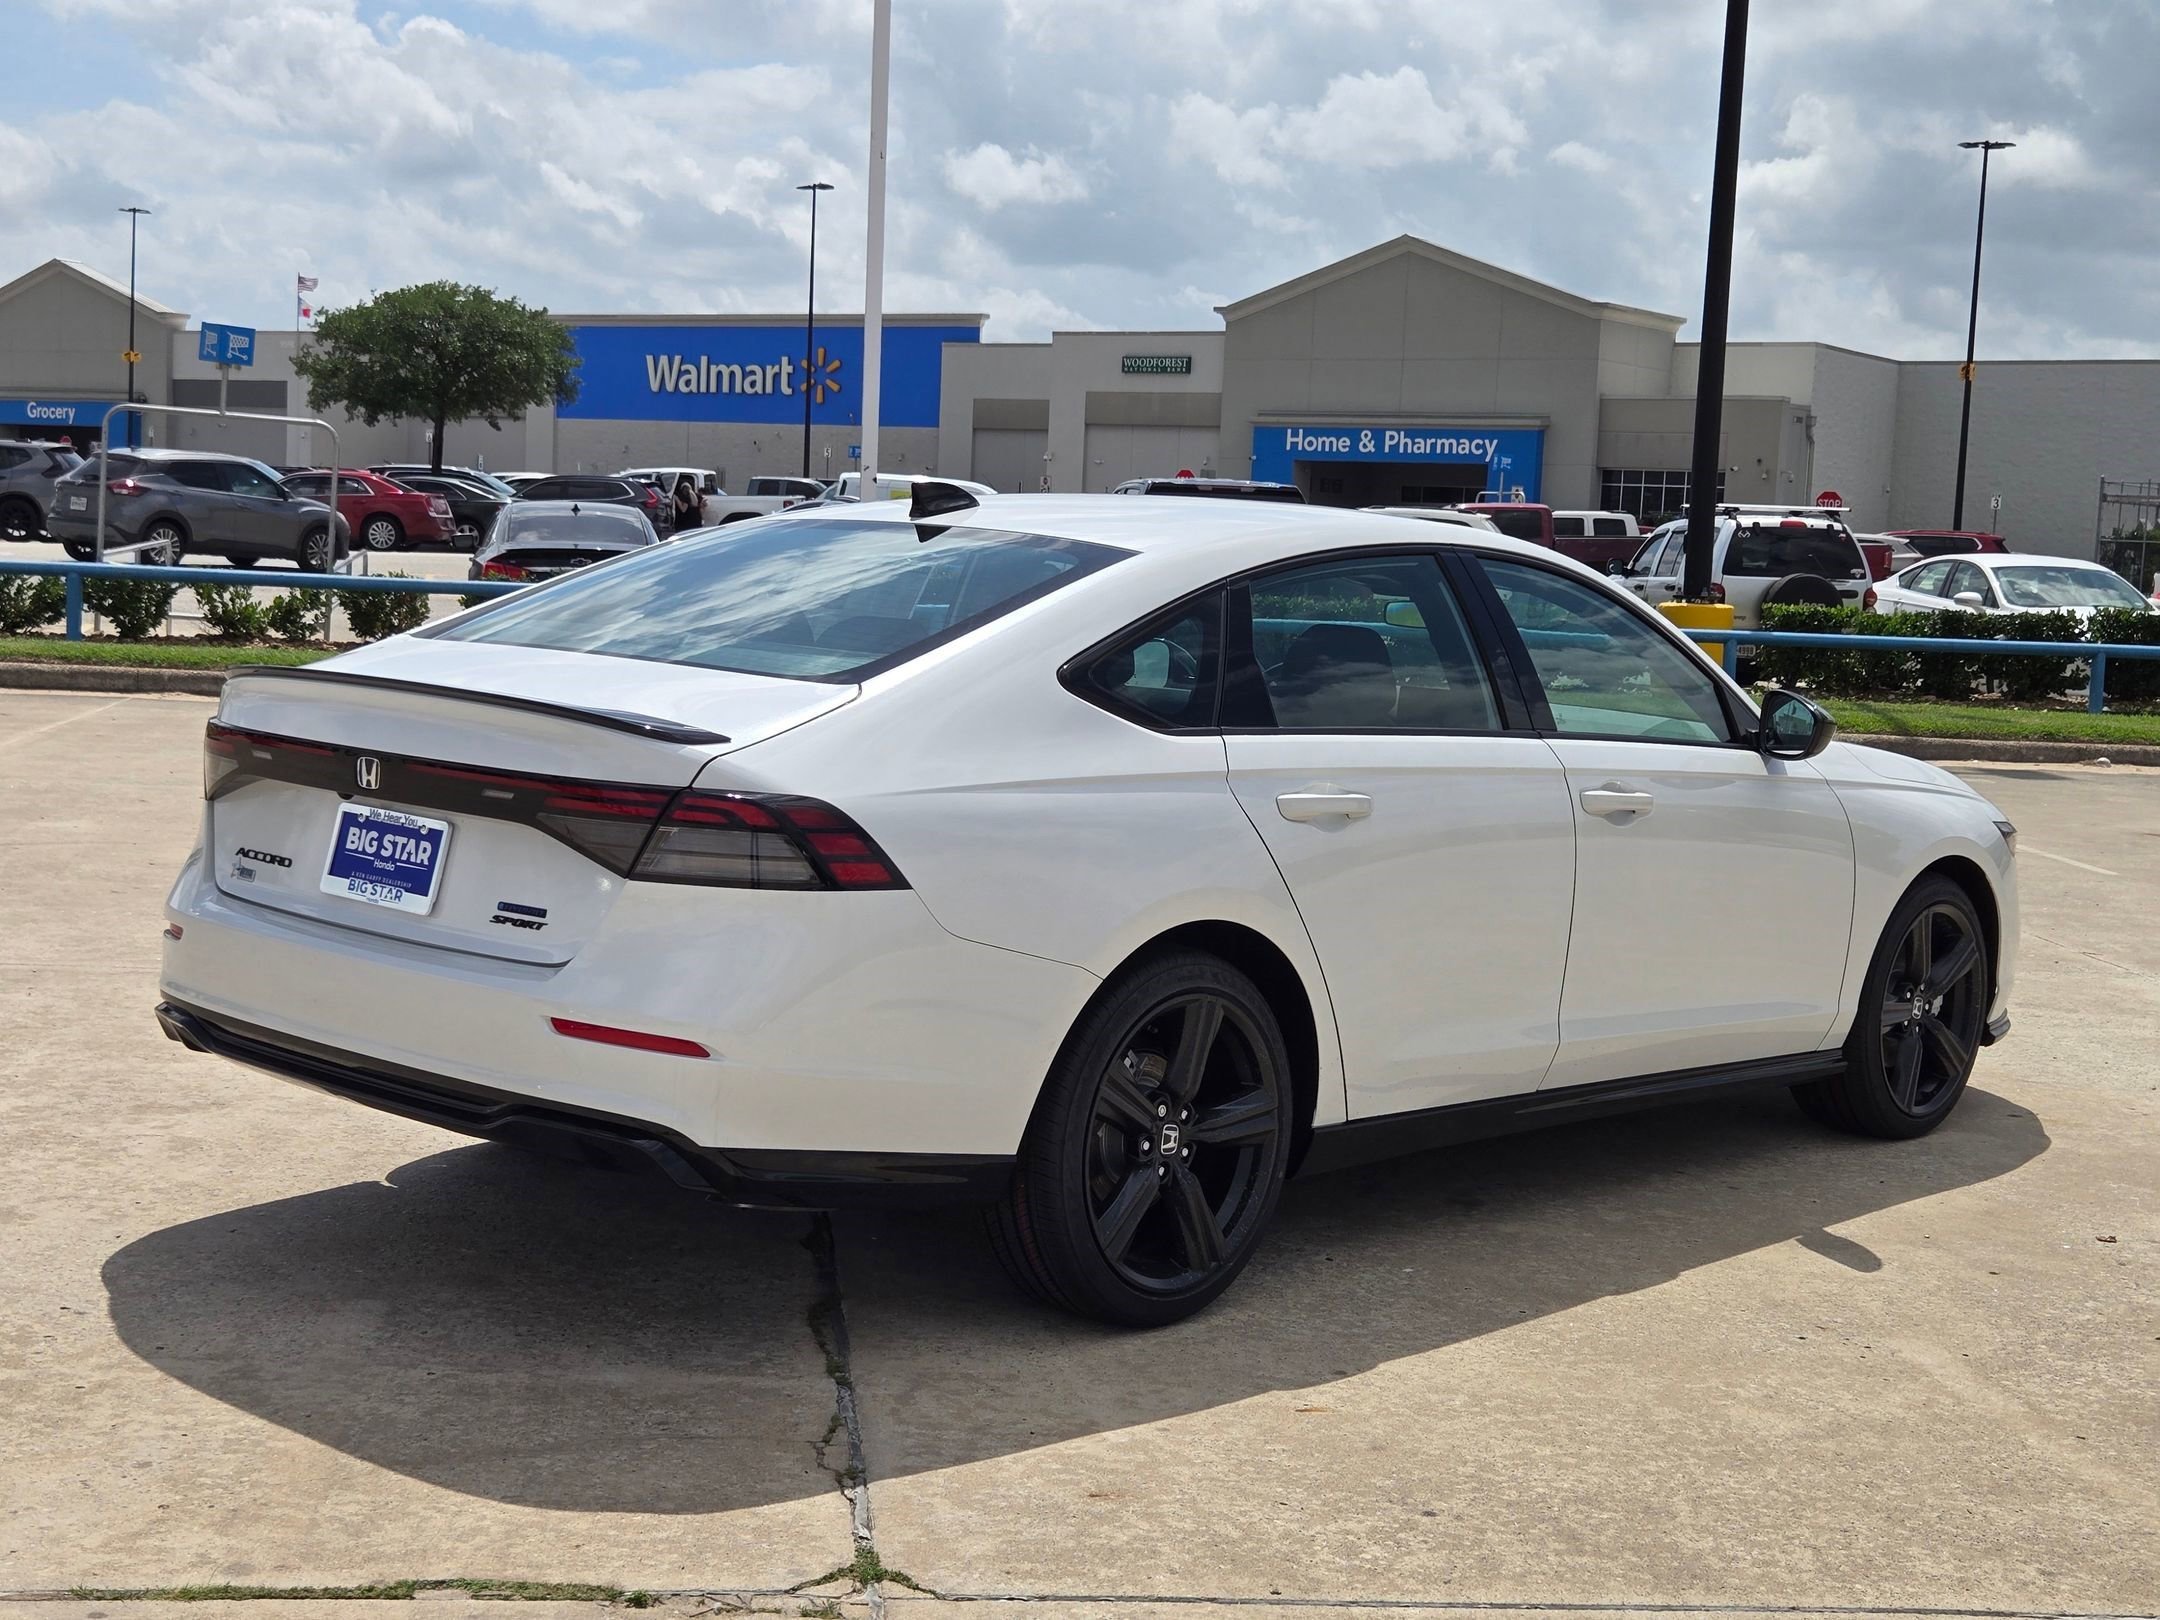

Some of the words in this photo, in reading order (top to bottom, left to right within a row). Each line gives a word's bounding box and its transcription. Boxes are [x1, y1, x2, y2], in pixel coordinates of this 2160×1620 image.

[1123, 358, 1188, 367] WOODFOREST
[646, 354, 793, 396] Walmart
[27, 401, 76, 425] Grocery
[1286, 429, 1351, 453] Home
[1358, 430, 1376, 453] &
[1384, 431, 1498, 462] Pharmacy
[1817, 499, 1841, 508] STOP
[1993, 499, 1999, 509] 3
[369, 809, 381, 819] We
[384, 812, 402, 823] Hear
[403, 815, 418, 827] You
[346, 827, 378, 853] BIG
[381, 834, 432, 865] STAR
[235, 847, 293, 868] ACCORD
[374, 859, 395, 871] Honda
[348, 879, 368, 894] BIG
[370, 883, 403, 902] STAR
[489, 915, 549, 931] SPORT
